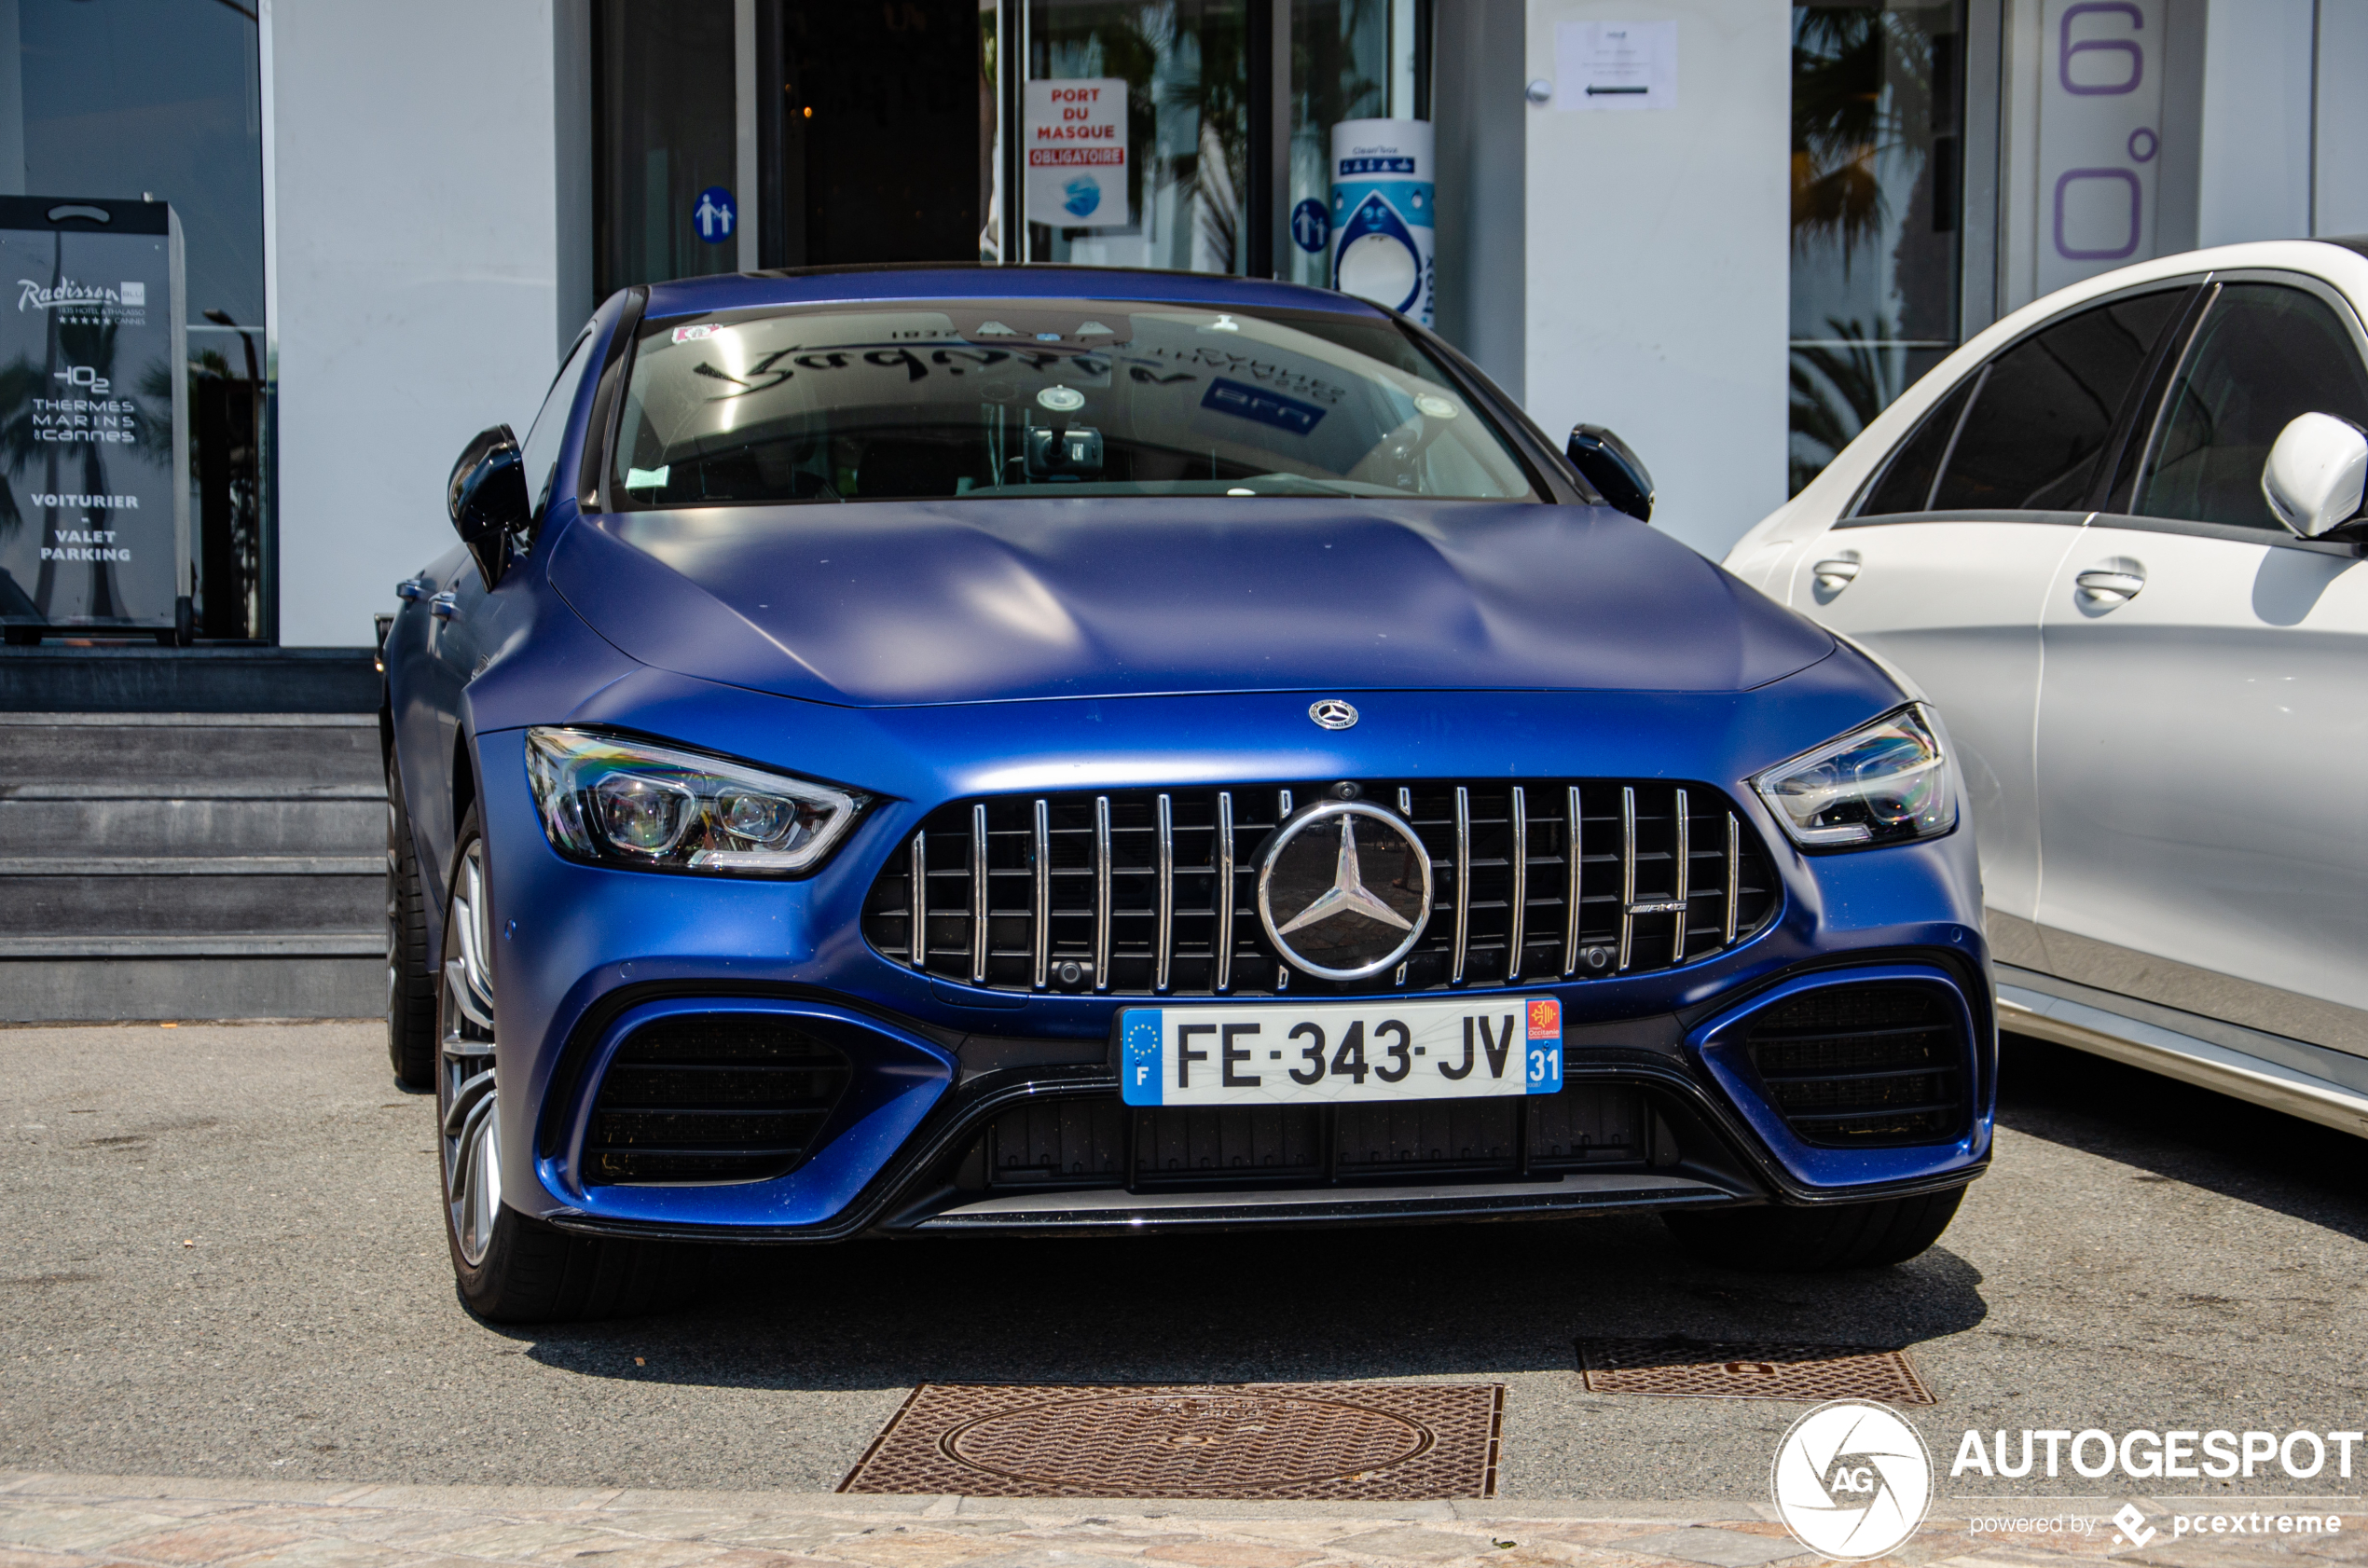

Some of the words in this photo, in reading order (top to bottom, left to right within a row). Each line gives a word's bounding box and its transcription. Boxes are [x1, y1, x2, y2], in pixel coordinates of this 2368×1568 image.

[1051, 88, 1100, 103] PORT
[1063, 107, 1089, 121] DU
[1037, 125, 1115, 140] MASQUE
[1032, 149, 1120, 163] OBLIGATOIRE
[17, 276, 119, 312] Radisson
[75, 307, 99, 315] HOTEL
[107, 308, 145, 316] THALASSO
[114, 317, 145, 325] CANNES
[33, 398, 134, 413] THERMES
[33, 414, 135, 428] MARINS
[31, 493, 139, 509] VOITURIER
[54, 530, 117, 543] VALET
[40, 547, 131, 561] PARKING
[1529, 1028, 1559, 1037] Occitanie
[1136, 1066, 1149, 1086] F
[1177, 1013, 1515, 1088] FE-343-JV
[1529, 1049, 1559, 1081] 31
